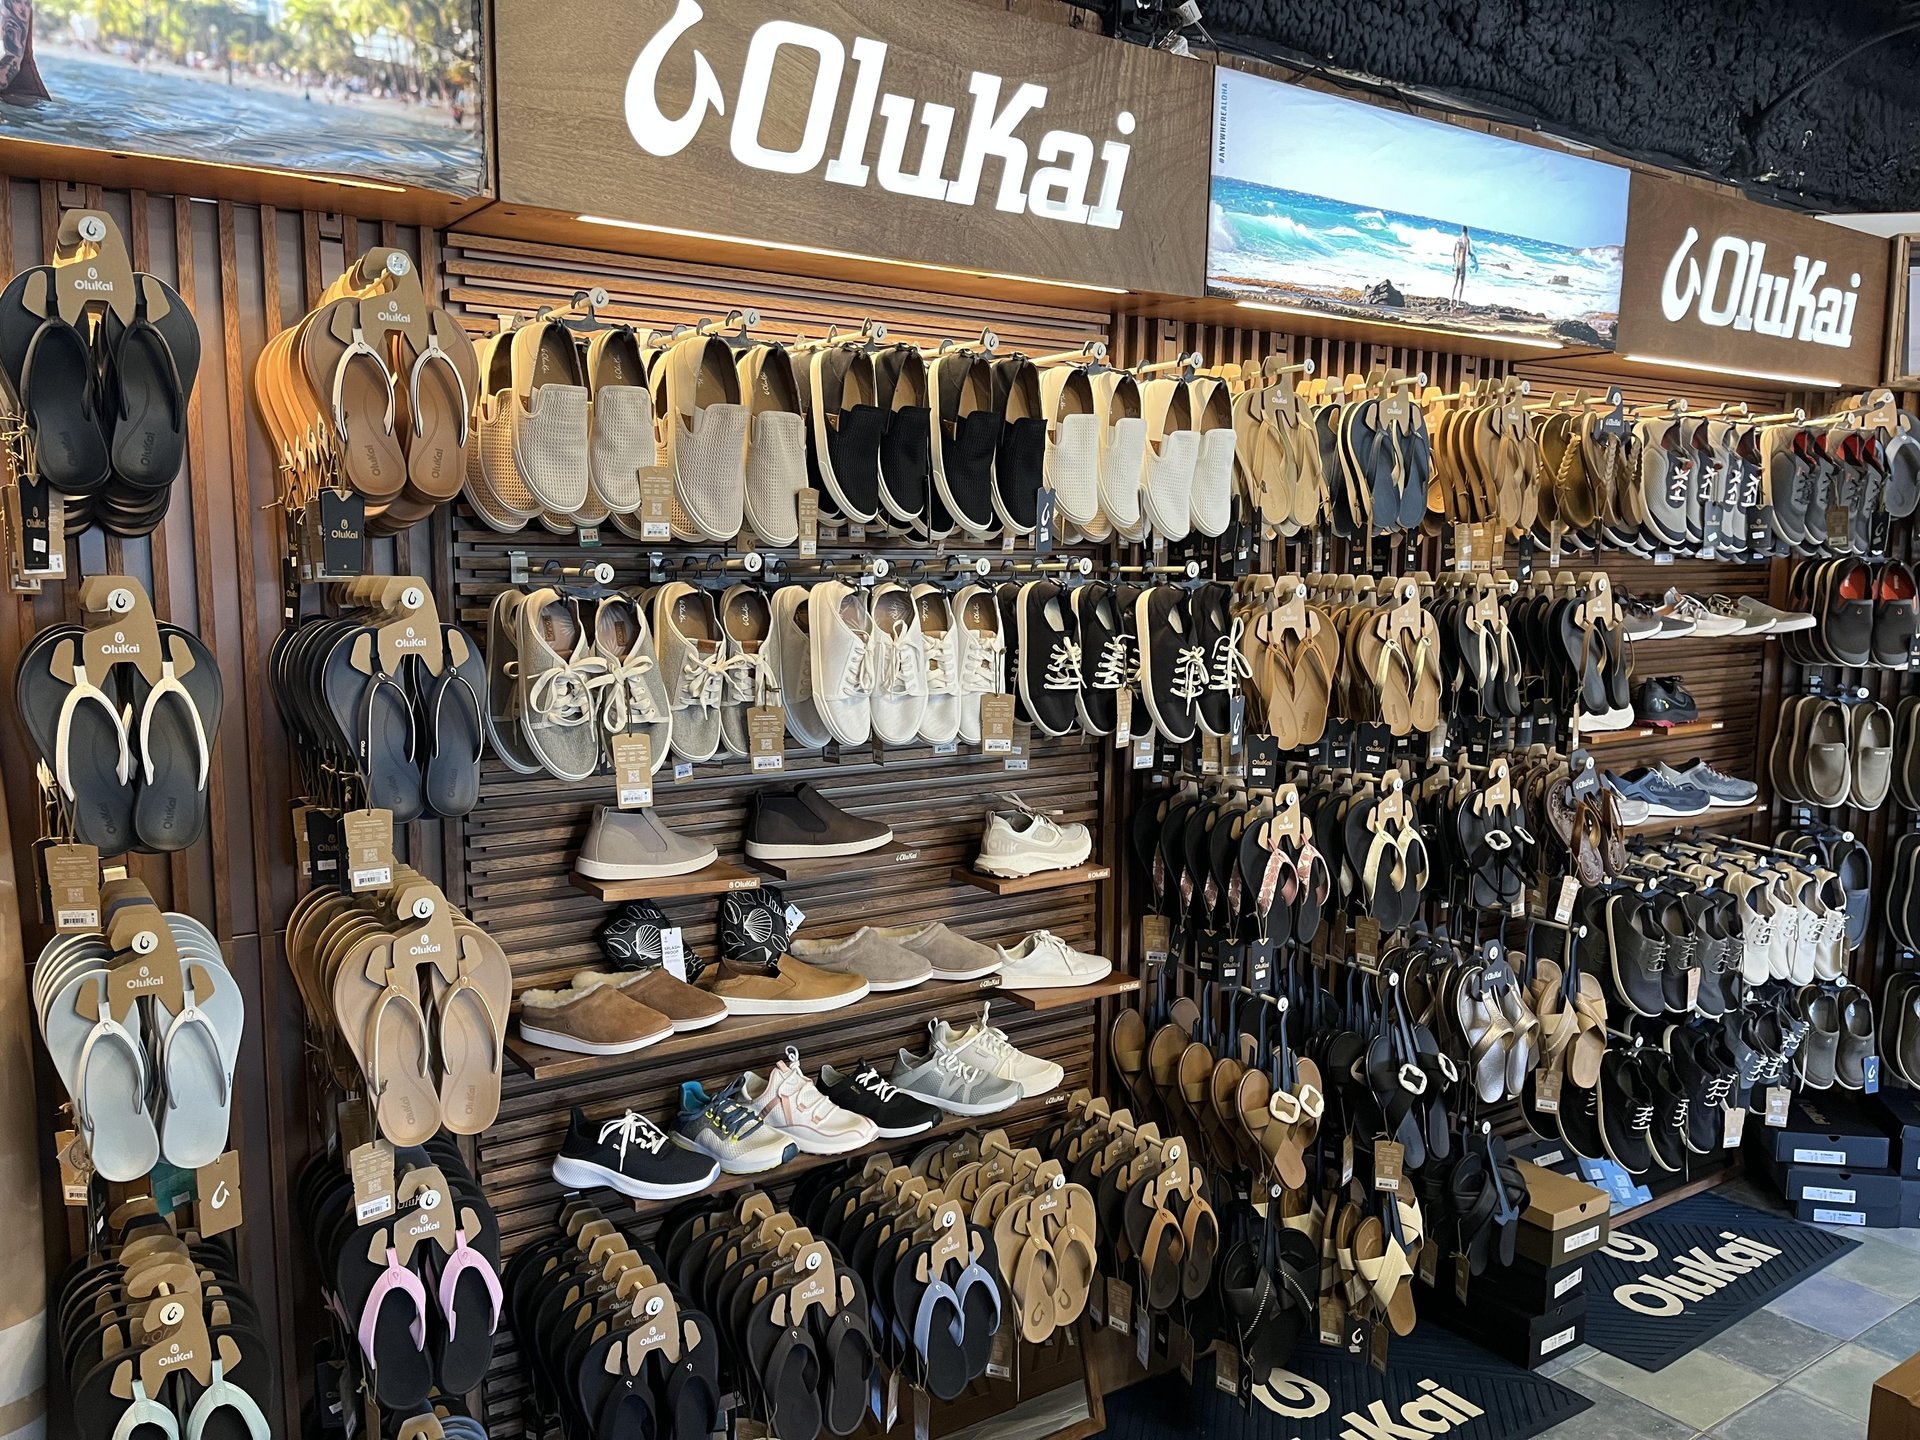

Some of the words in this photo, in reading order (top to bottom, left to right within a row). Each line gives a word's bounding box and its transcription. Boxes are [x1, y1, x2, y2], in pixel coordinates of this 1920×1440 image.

[729, 20, 1136, 230] OluKai
[1218, 83, 1228, 164] #ANYWHEREALOHA
[74, 279, 113, 292] OluKai
[1698, 236, 1861, 348] OluKai
[377, 311, 411, 324] OluKai
[431, 448, 444, 479] OluKai
[331, 530, 358, 540] OluKai
[101, 644, 140, 655] OluKai
[395, 638, 427, 648] OluKai
[735, 879, 757, 888] OluKai
[409, 944, 441, 955] OluKai
[126, 975, 164, 988] OluKai
[410, 1222, 440, 1235] OluKai
[941, 1241, 960, 1254] OluKai
[1613, 1231, 1783, 1317] OluKai
[801, 1287, 825, 1299] OluKai
[640, 1332, 666, 1347] OluKai
[158, 1350, 194, 1367] OluKai
[1338, 1378, 1485, 1440] Kai
